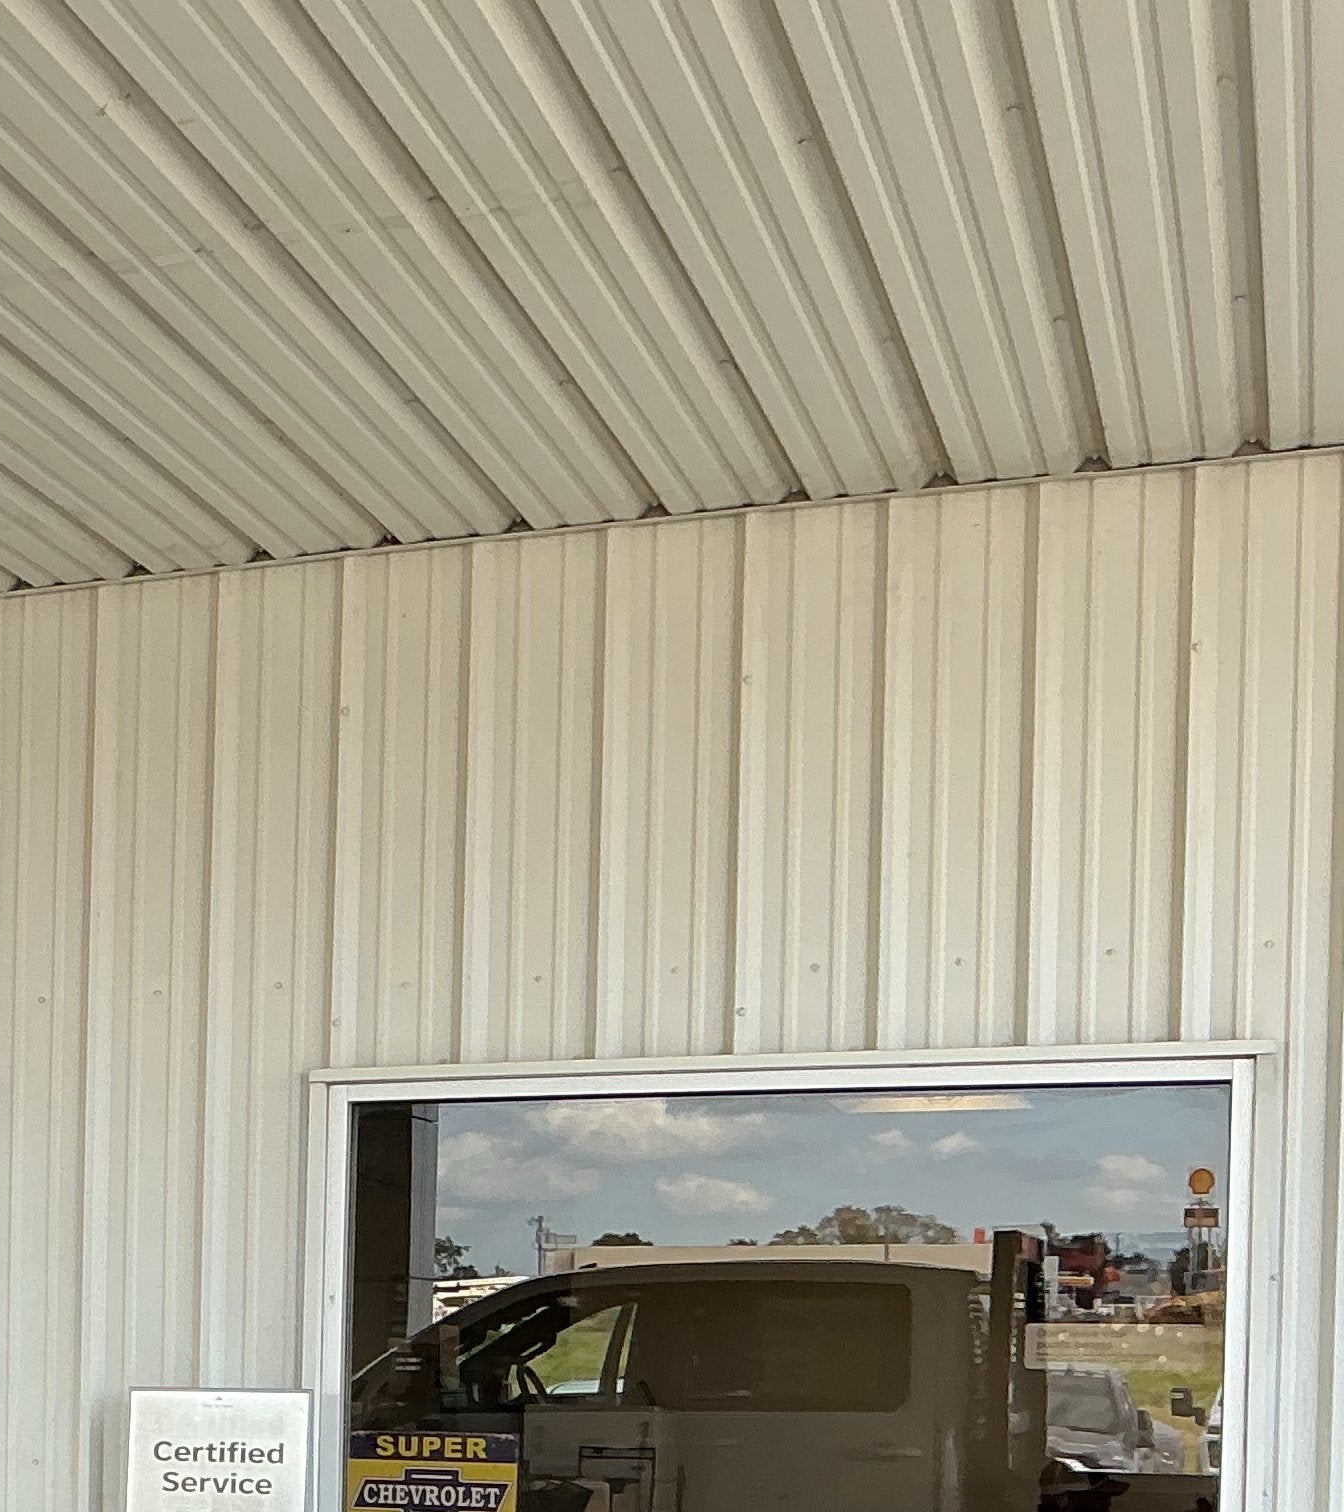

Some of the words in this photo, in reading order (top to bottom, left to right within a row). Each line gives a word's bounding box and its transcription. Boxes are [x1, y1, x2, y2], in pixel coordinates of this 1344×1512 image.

[153, 1440, 285, 1465] Certified
[375, 1435, 488, 1459] SUPER
[161, 1471, 273, 1495] Service
[363, 1483, 500, 1508] CHEVROLET
